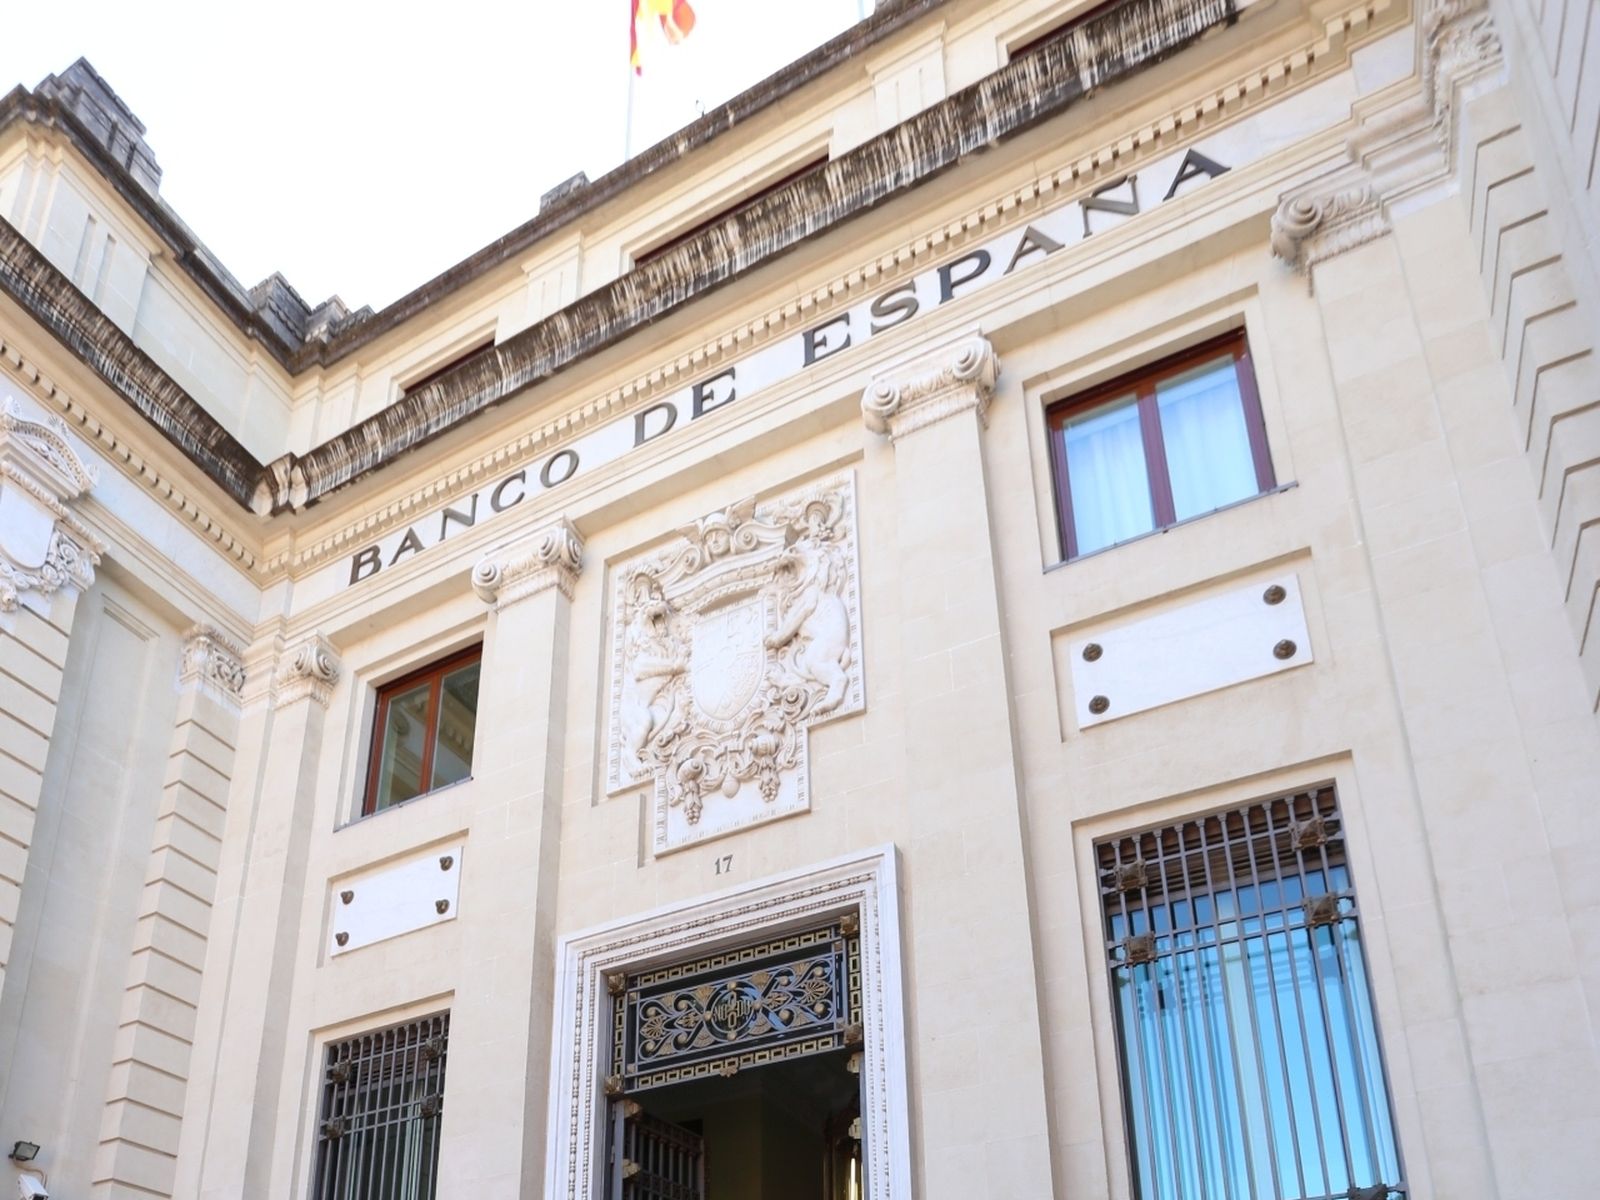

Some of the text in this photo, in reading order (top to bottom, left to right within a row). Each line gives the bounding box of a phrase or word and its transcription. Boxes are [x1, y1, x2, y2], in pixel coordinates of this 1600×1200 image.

[347, 148, 1232, 586] BANCO DE ESPAÑA
[714, 854, 734, 875] 17
